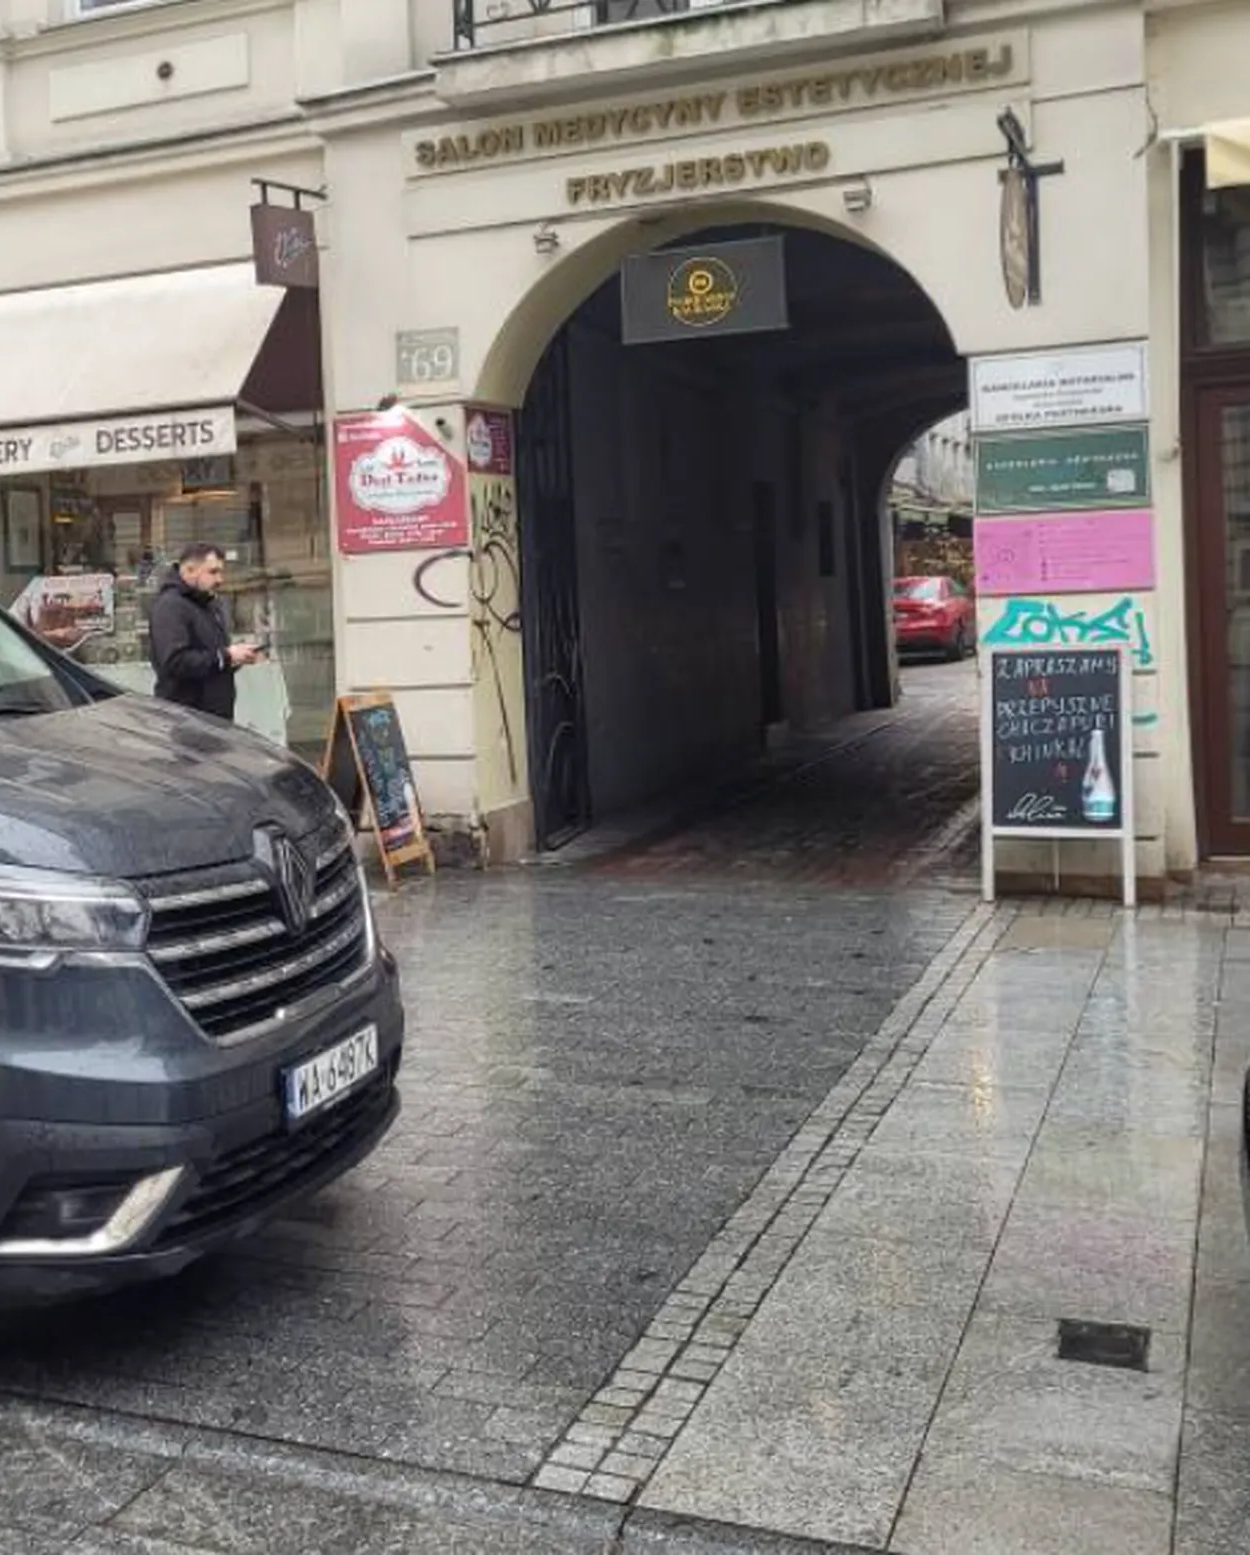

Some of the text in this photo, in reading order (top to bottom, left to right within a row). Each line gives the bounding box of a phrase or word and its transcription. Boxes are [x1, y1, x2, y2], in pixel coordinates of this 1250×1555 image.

[415, 44, 1013, 168] SALON MEDYCYNY ESTETYCZNEJ
[566, 141, 831, 203] FRYZJERSTWO
[411, 343, 453, 380] 69
[95, 420, 215, 454] DESSERTS
